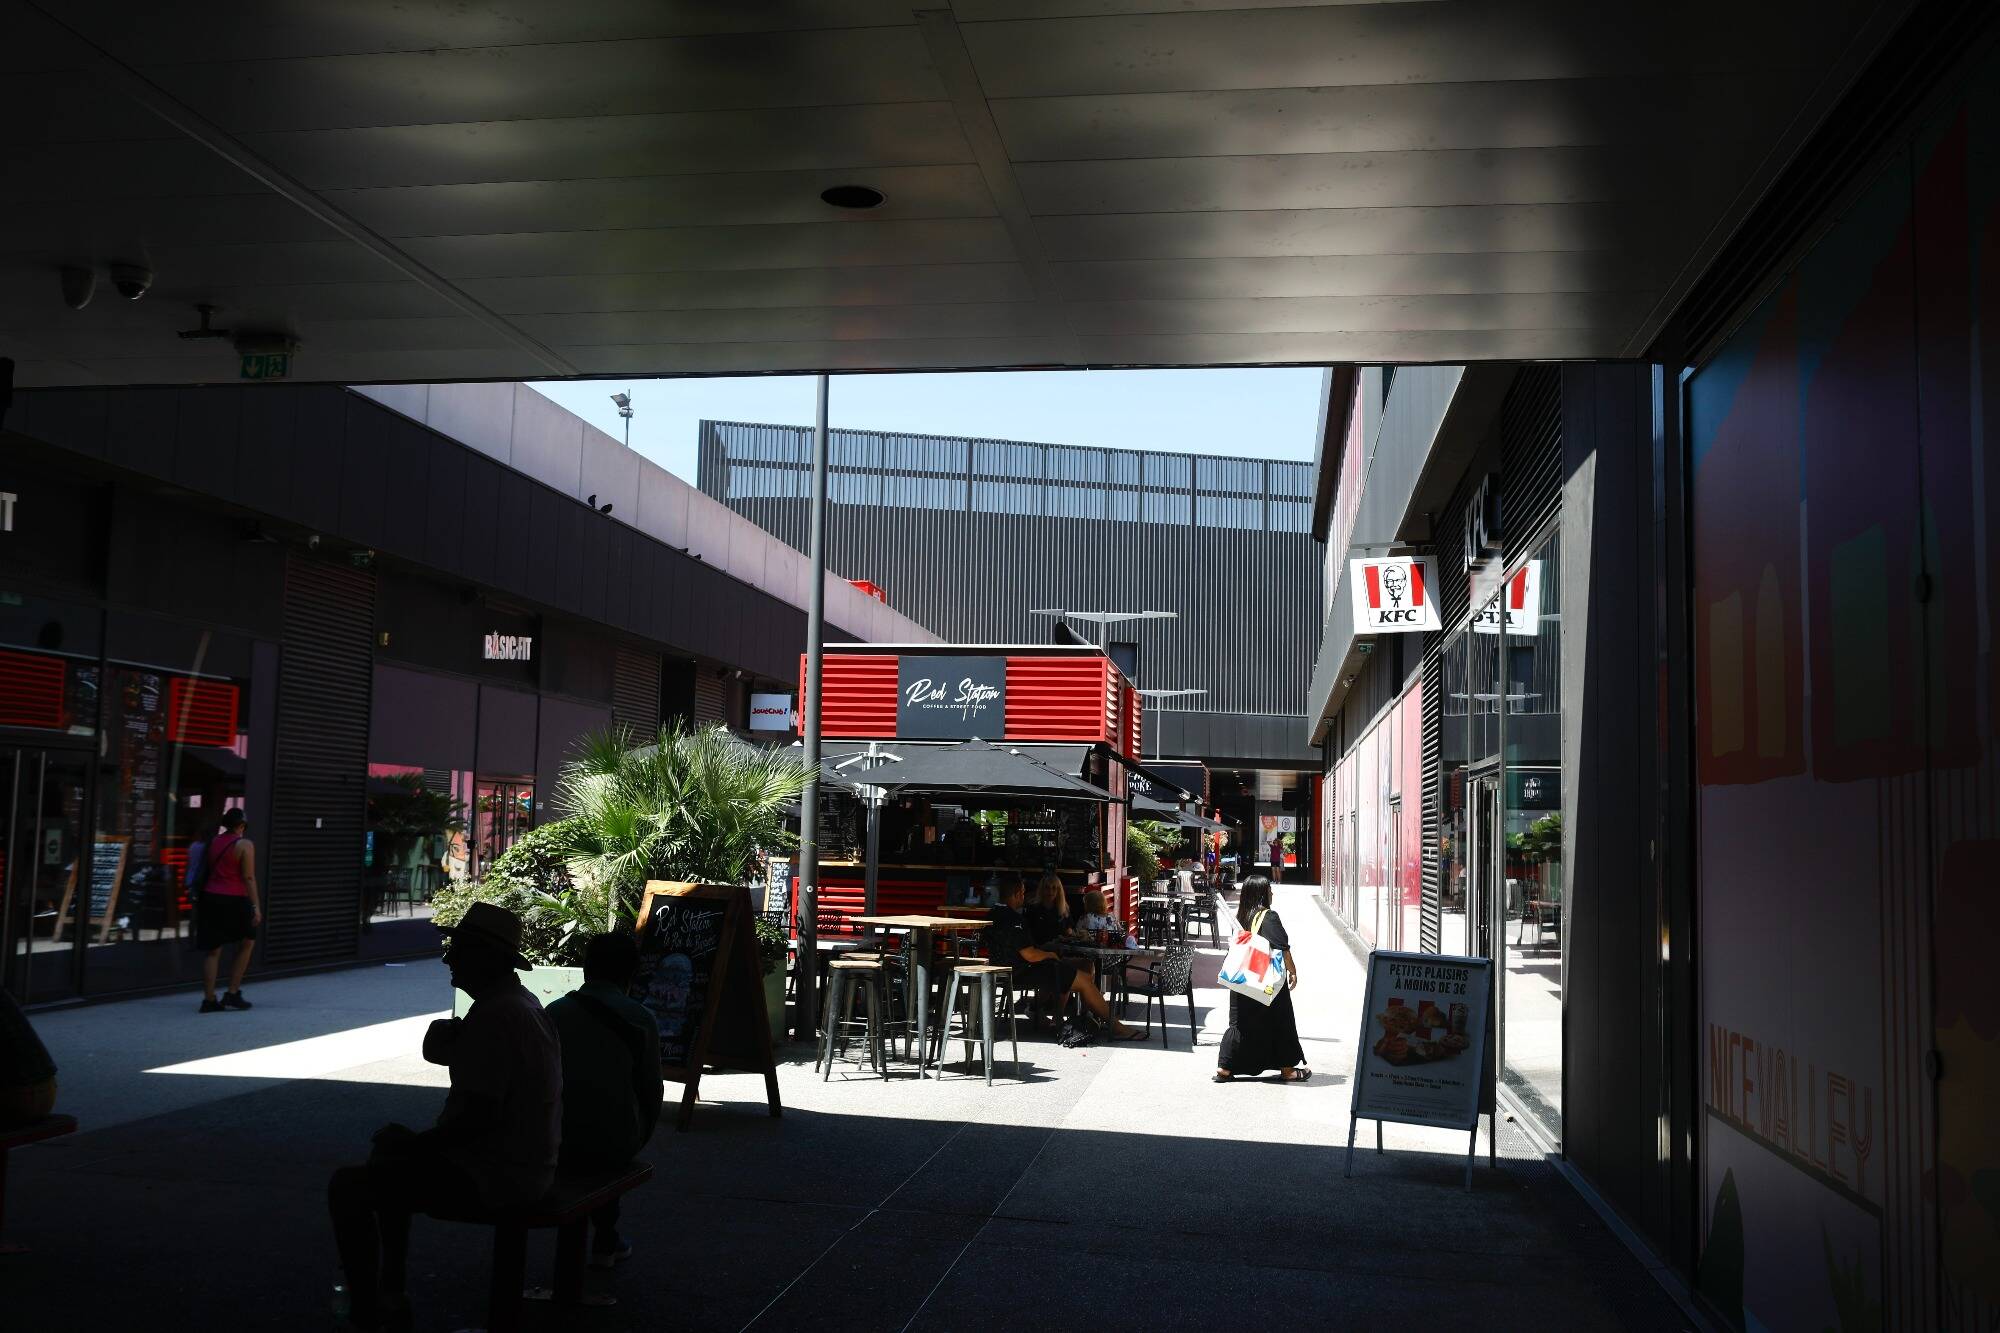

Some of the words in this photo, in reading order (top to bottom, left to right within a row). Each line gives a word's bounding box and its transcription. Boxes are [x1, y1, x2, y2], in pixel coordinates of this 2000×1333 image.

[1379, 609, 1417, 623] KFC
[906, 678, 947, 707] Red
[954, 677, 1000, 721] Station
[1390, 964, 1422, 978] PETITS
[1424, 966, 1469, 981] PLAISIRS
[1404, 979, 1435, 993] MOINS
[1438, 982, 1451, 994] DE
